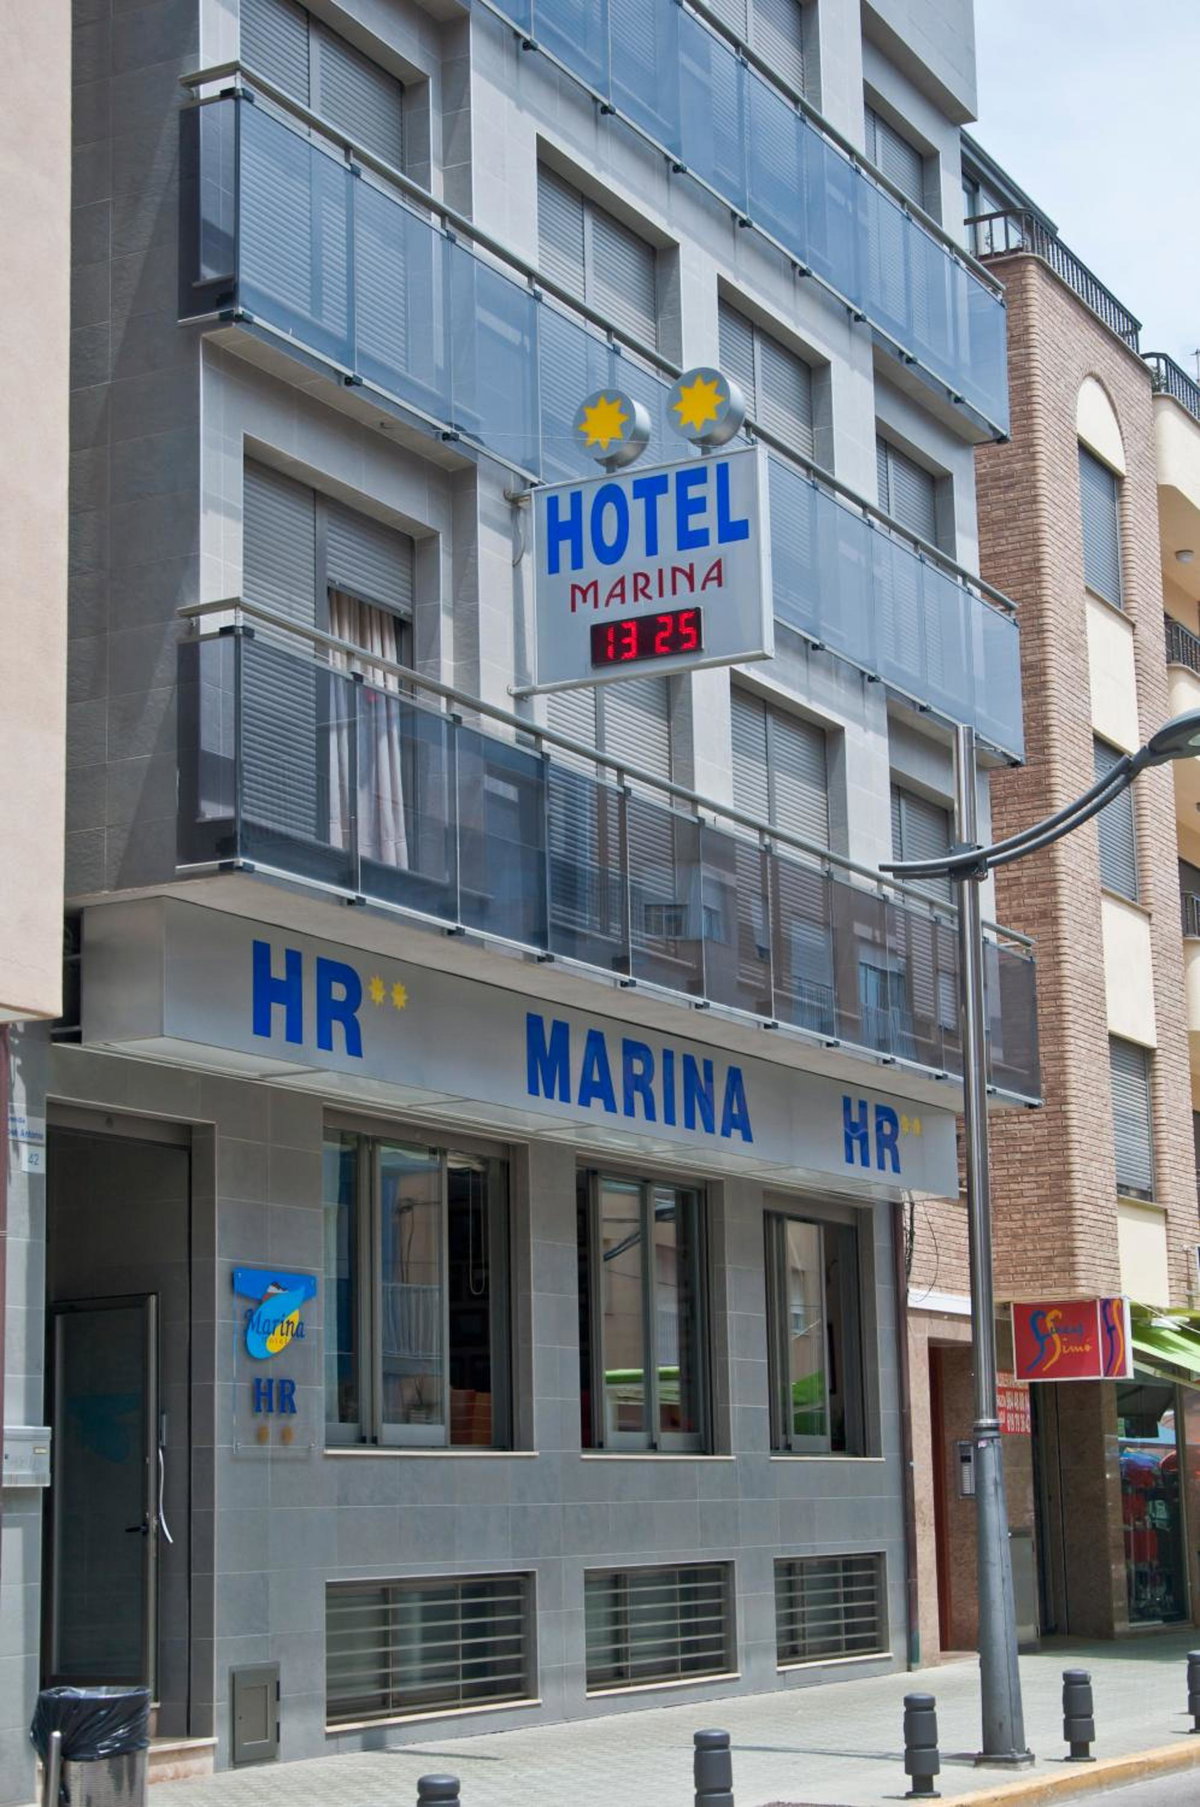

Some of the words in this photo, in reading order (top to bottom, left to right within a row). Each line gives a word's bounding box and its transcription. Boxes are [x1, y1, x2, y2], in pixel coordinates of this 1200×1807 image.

[546, 461, 750, 575] HOTEL
[570, 557, 724, 613] MARINA
[606, 620, 639, 660] 13
[654, 610, 698, 654] 25
[252, 939, 363, 1059] HR
[526, 1012, 754, 1144] MARINA
[843, 1095, 902, 1174] HR
[244, 1308, 305, 1338] Marina
[254, 1377, 297, 1414] HR
